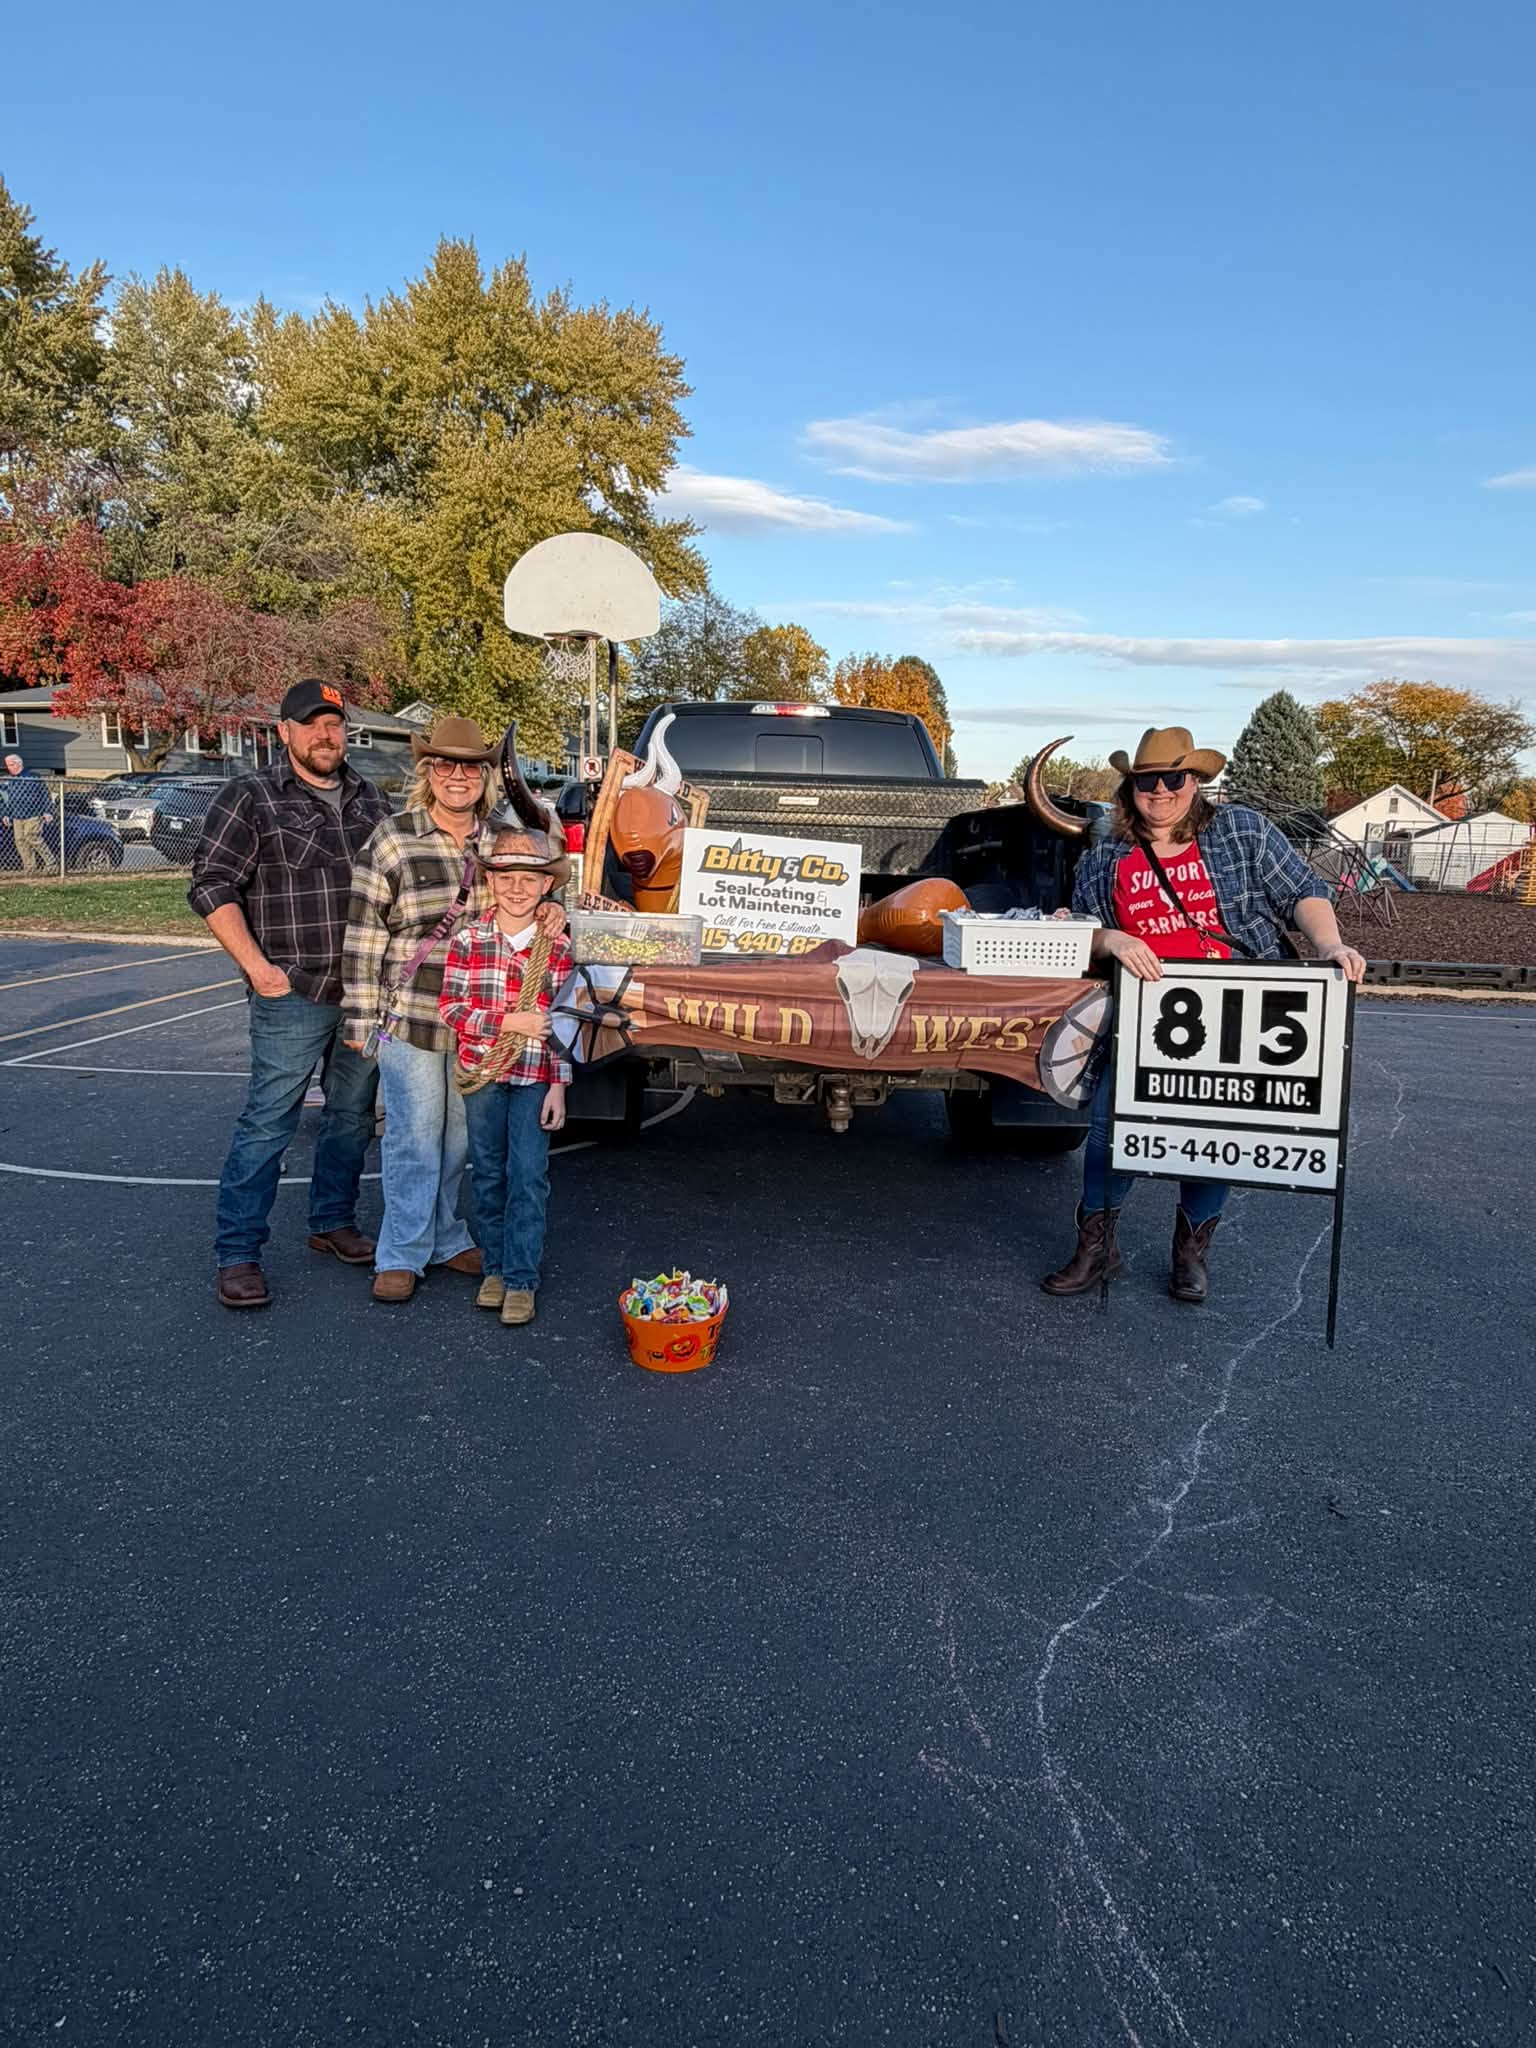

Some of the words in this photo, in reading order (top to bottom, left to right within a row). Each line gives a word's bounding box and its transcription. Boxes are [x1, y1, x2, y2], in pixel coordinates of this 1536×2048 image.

[701, 838, 784, 884] Bitty
[799, 855, 849, 886] Co.
[698, 893, 727, 908] Lot
[729, 896, 842, 918] Maintenance
[715, 880, 815, 904] Sealcoating
[1128, 899, 1154, 915] your
[713, 914, 737, 927] Call
[738, 917, 755, 929] For
[756, 919, 776, 930] Free
[663, 997, 814, 1046] WILD
[1152, 987, 1308, 1067] 815
[1148, 1073, 1256, 1102] BUILDERS
[1265, 1080, 1312, 1107] INC.
[1123, 1133, 1327, 1174] 815-440-8278
